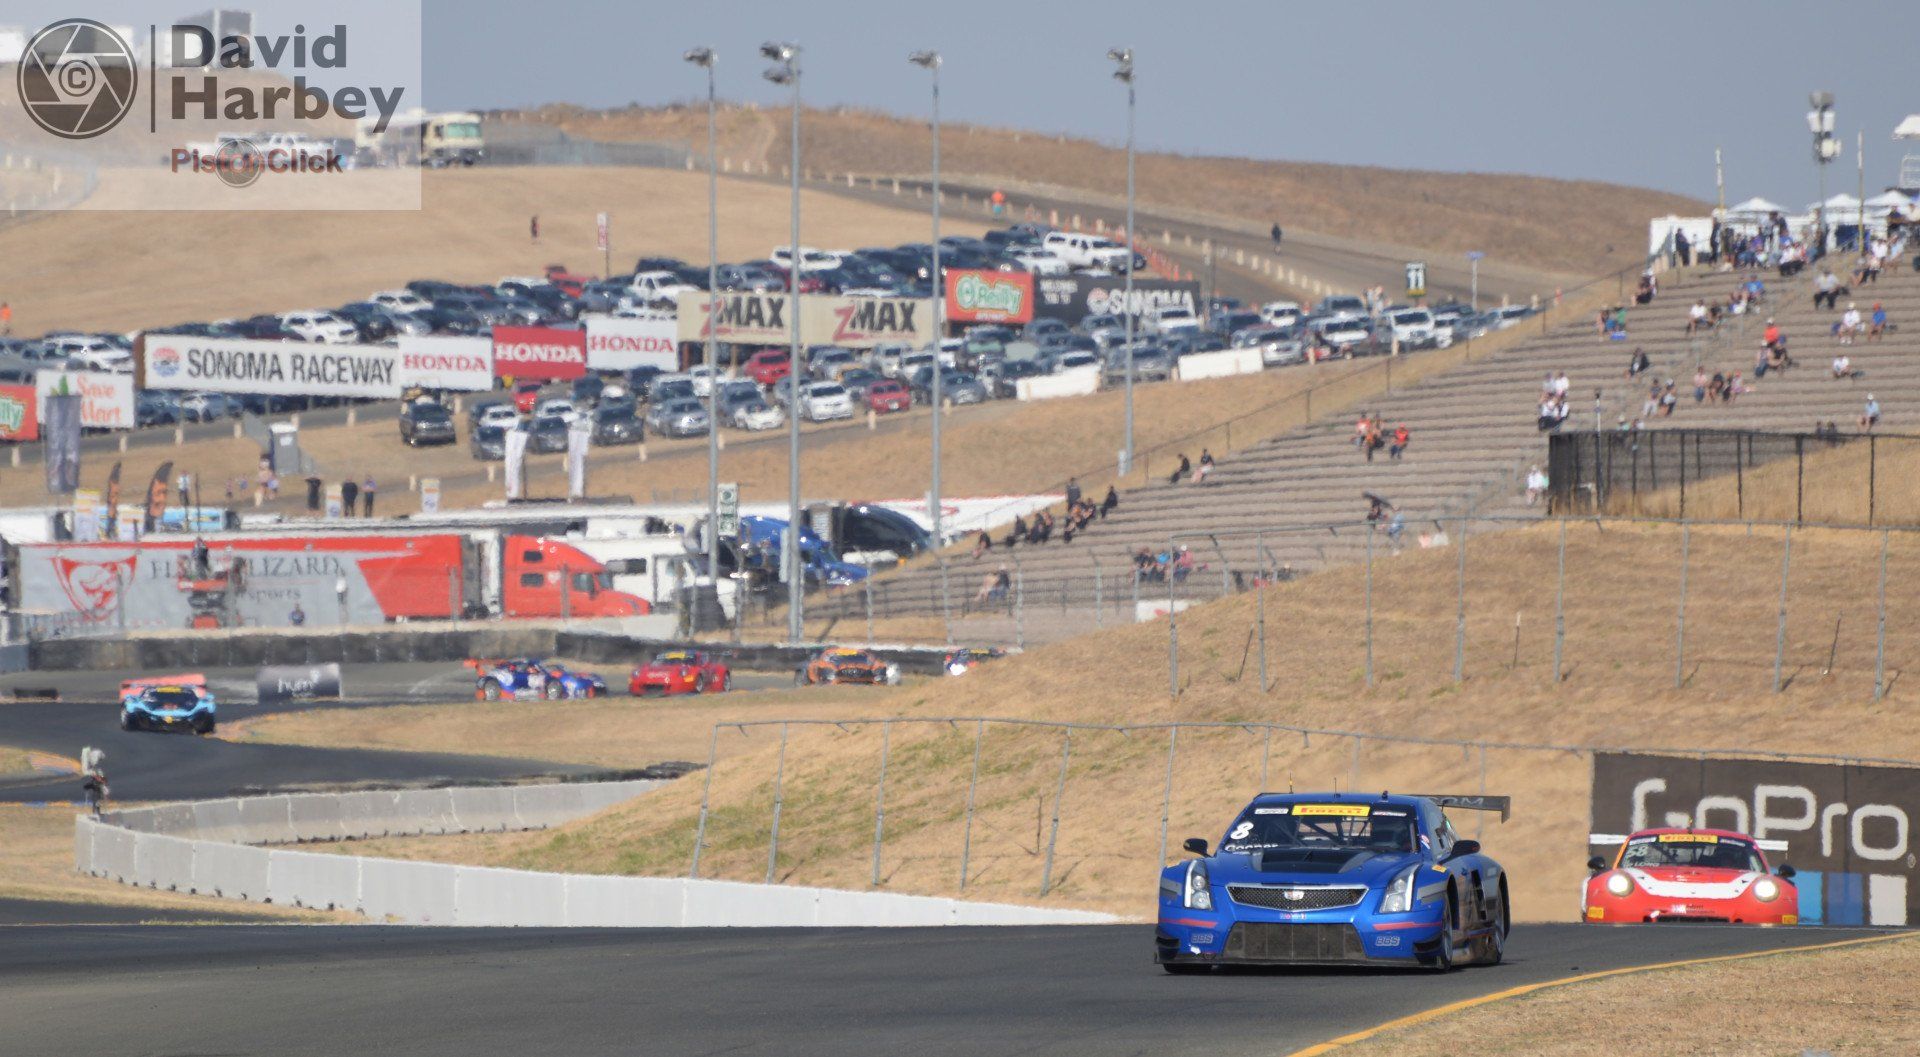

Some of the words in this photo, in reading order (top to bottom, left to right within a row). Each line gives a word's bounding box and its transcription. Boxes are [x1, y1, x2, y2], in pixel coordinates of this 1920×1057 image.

[590, 336, 674, 352] HONDA
[495, 344, 584, 363] HONDA
[188, 349, 284, 381] SONOMA
[291, 354, 395, 386] RACEWAY
[403, 354, 487, 372] HONDA
[1631, 777, 1910, 861] GoPro
[1230, 822, 1255, 840] 8
